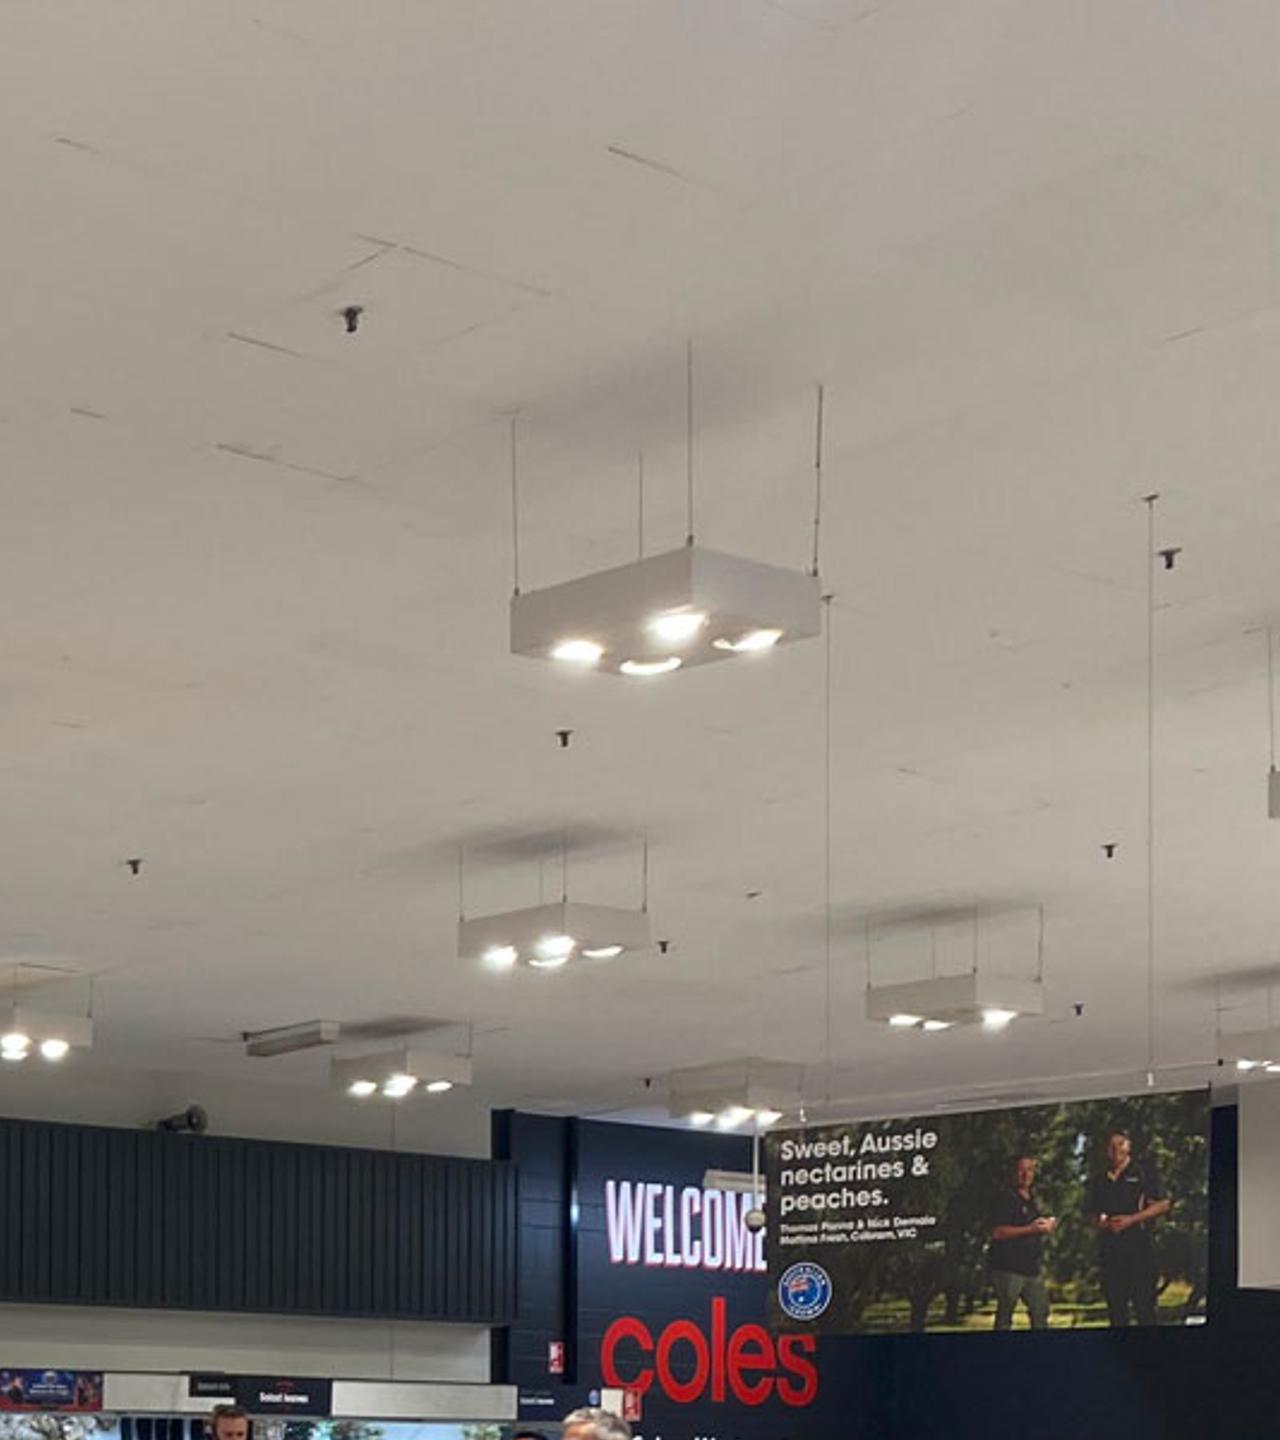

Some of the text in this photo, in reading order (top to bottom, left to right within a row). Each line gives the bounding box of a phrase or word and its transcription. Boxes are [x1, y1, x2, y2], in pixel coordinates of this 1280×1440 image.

[781, 1128, 938, 1161] Sweet, Aussie
[781, 1155, 930, 1186] nectarines &
[781, 1187, 889, 1216] peaches.
[605, 1180, 768, 1271] WELCOME
[897, 1228, 918, 1238] VIC
[601, 1297, 819, 1407] coles
